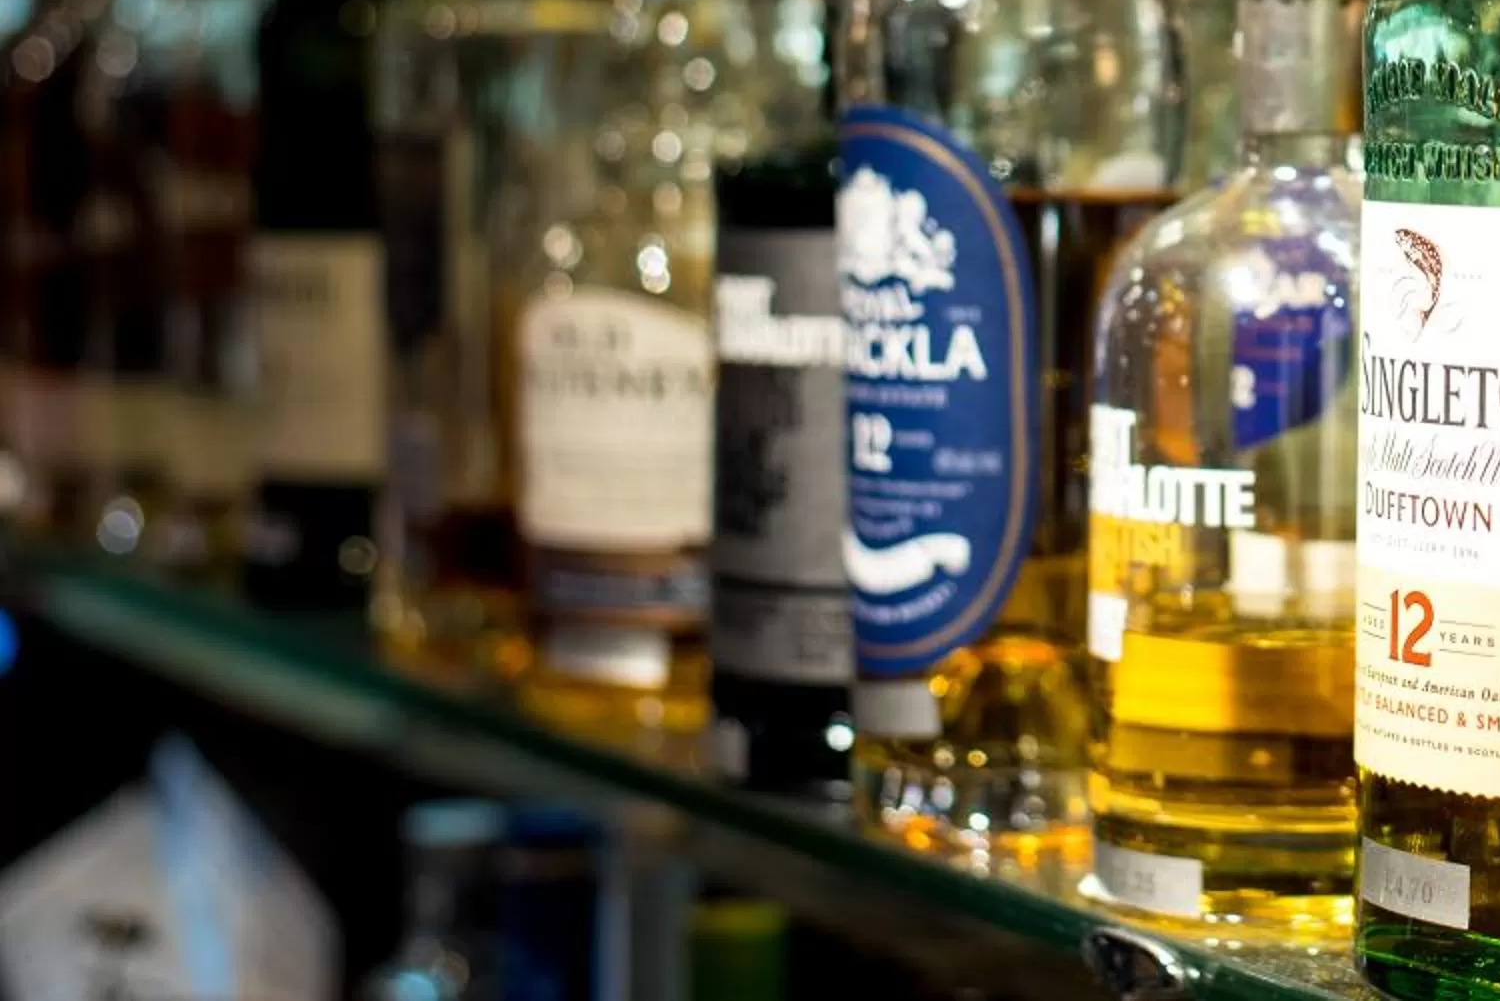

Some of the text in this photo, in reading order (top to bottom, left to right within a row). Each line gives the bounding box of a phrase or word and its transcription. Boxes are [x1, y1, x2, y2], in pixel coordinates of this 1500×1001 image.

[1409, 433, 1478, 481] Scotch
[1365, 480, 1492, 532] DUFFTOWN
[1388, 589, 1435, 668] 12
[1439, 630, 1495, 648] YEARS
[1375, 694, 1449, 725] BALANCED
[1457, 710, 1468, 728] &
[1402, 674, 1418, 691] and
[1422, 677, 1476, 700] American
